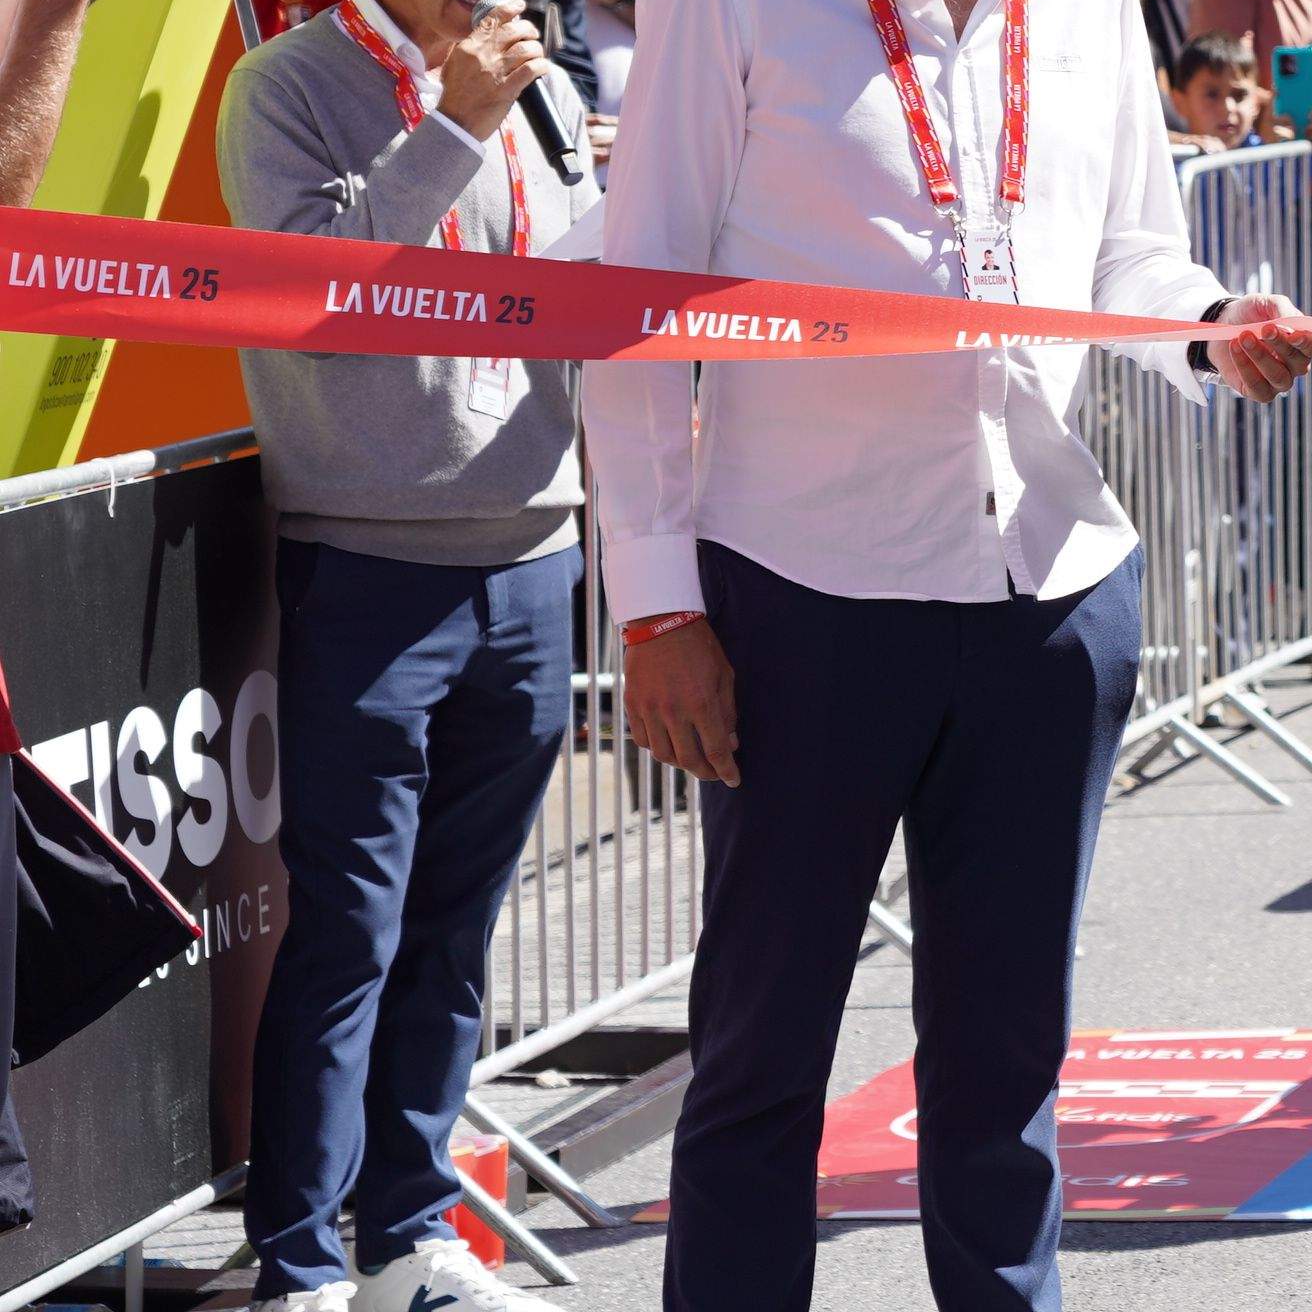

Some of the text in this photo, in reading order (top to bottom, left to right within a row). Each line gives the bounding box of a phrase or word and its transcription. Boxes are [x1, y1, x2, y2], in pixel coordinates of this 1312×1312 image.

[8, 252, 220, 302] LA VUELTA 25
[325, 280, 536, 325] LA VUELTA 25
[641, 308, 850, 344] LA VUELTA 25
[955, 330, 993, 349] LA
[1097, 1048, 1246, 1060] VUELTA
[1253, 1048, 1308, 1060] 25
